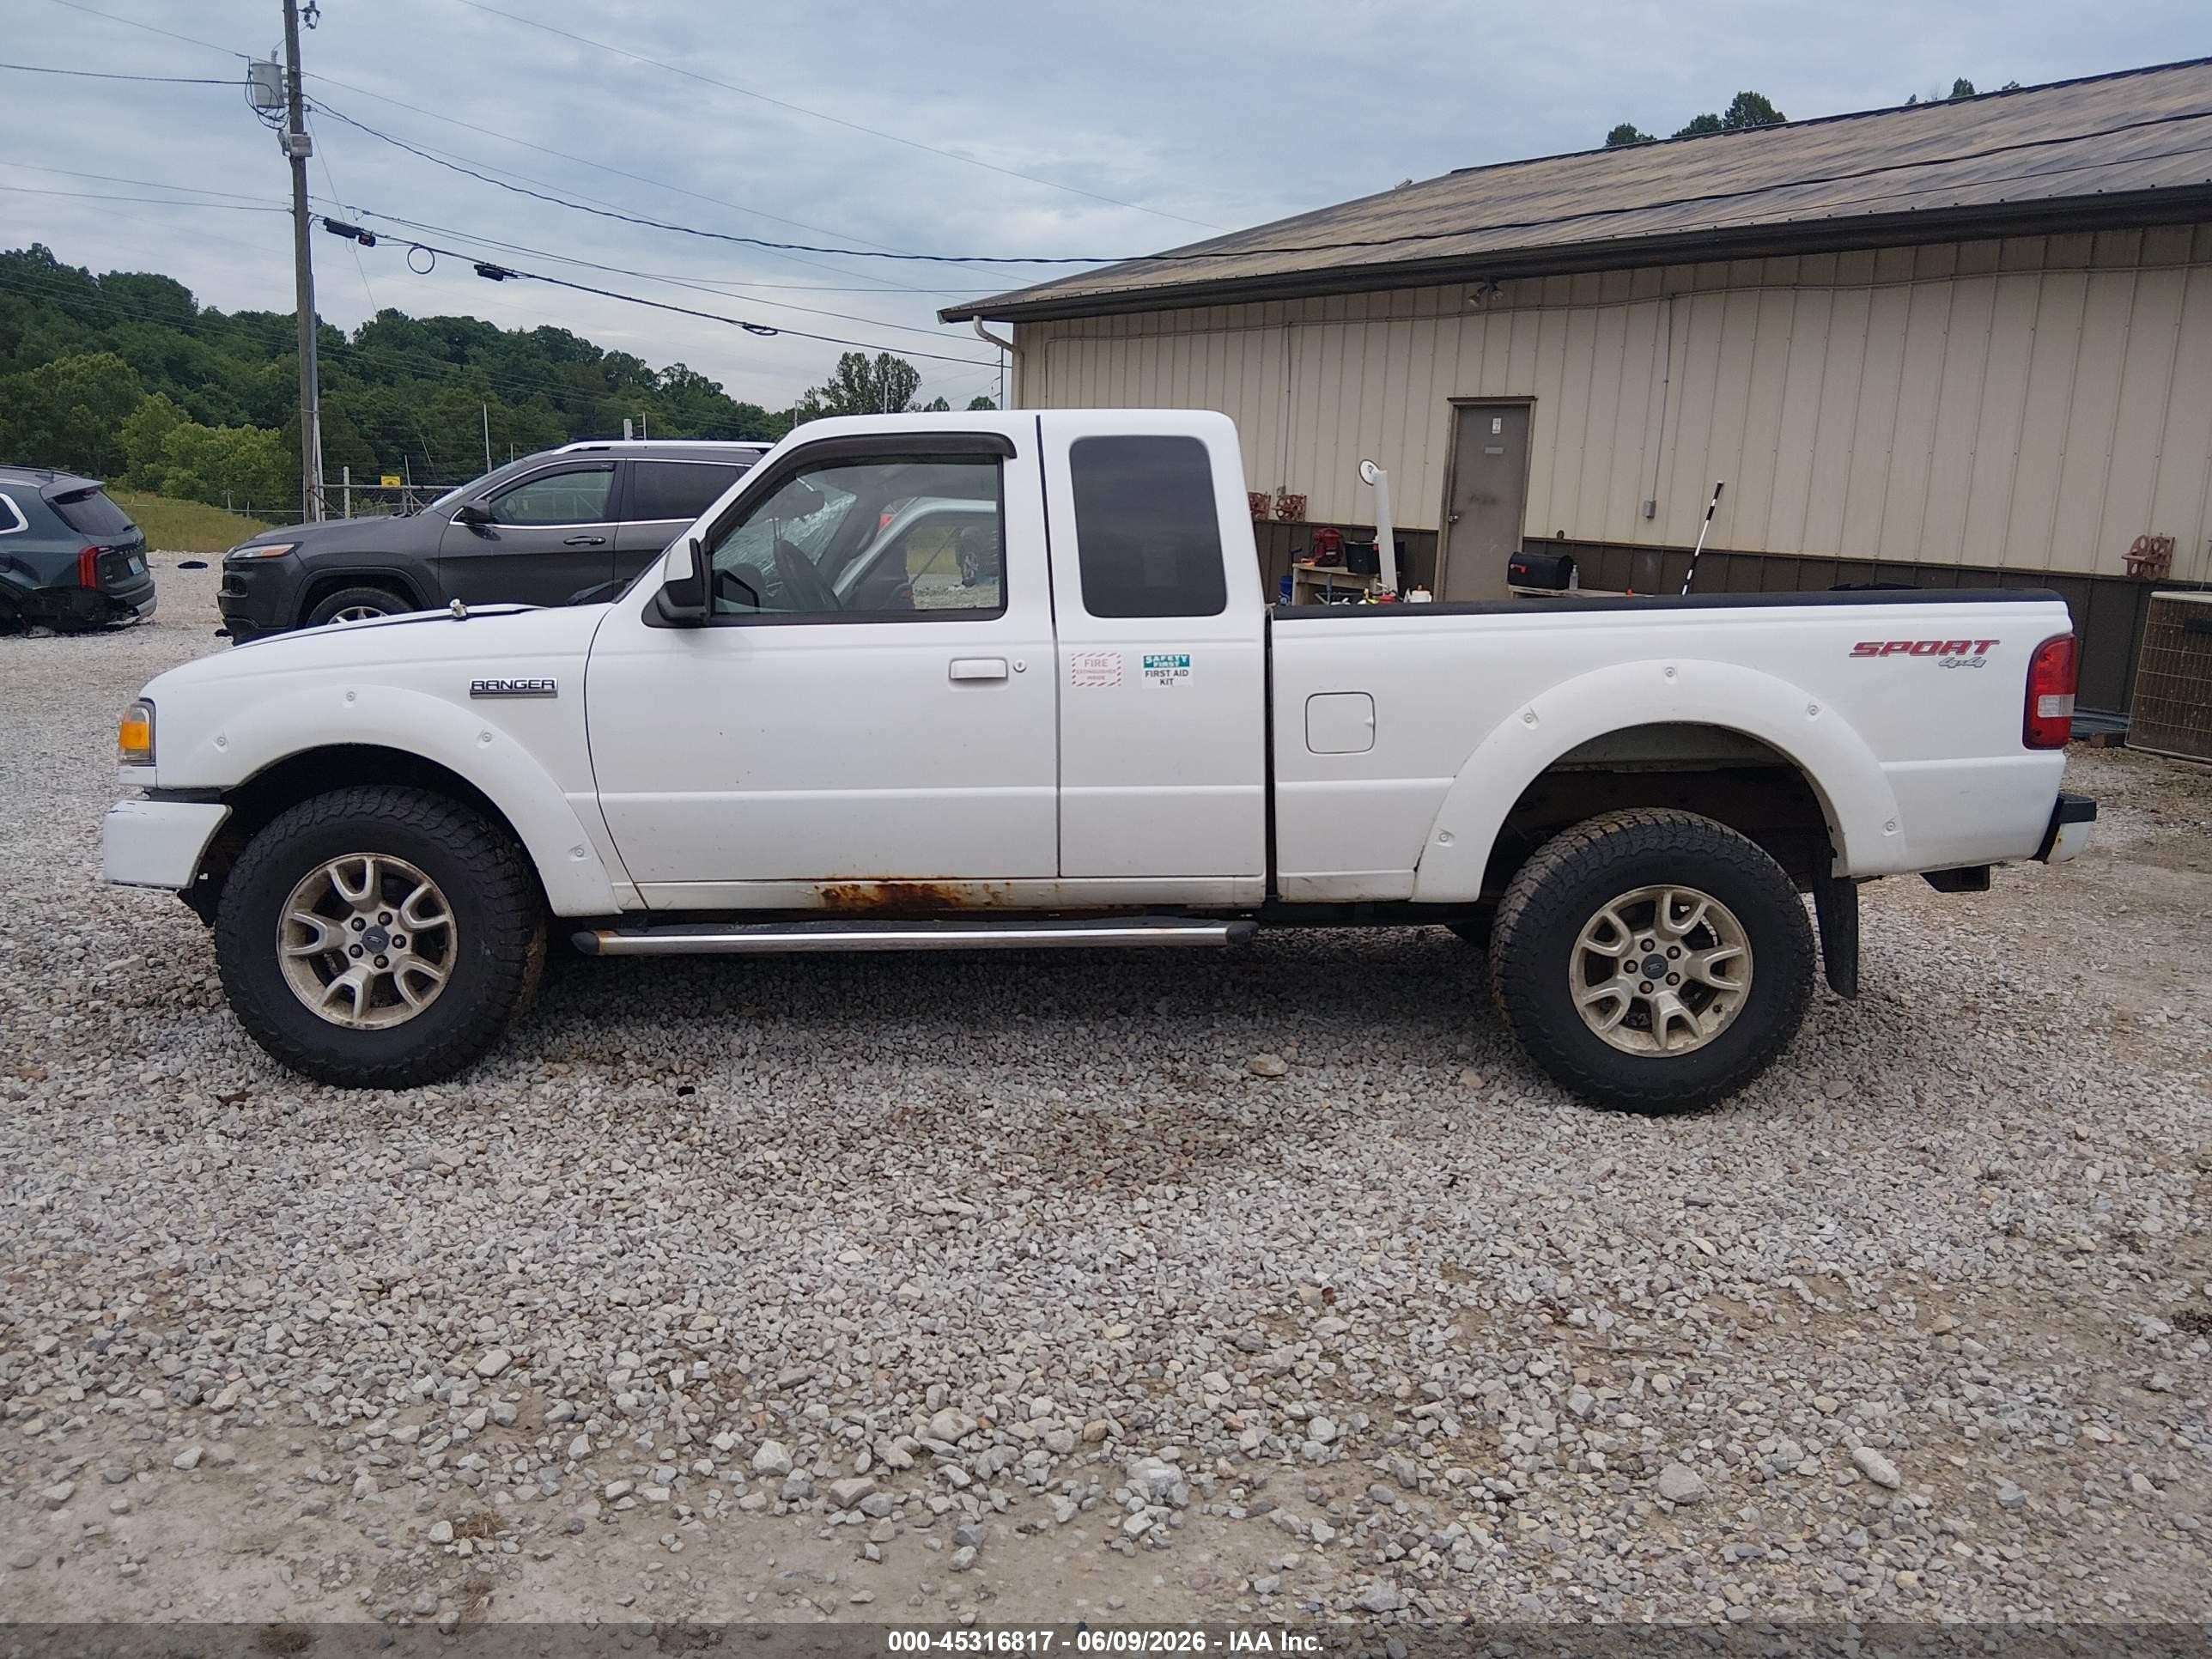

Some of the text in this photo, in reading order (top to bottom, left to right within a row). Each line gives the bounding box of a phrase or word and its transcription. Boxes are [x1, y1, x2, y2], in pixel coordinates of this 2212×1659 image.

[1849, 640, 2001, 658] SPORT
[1085, 659, 1109, 667] FIRE
[1145, 655, 1188, 664] SAFETY
[1938, 657, 1987, 668] 4x4
[1145, 669, 1170, 678] FIRST
[471, 679, 556, 690] RANGER
